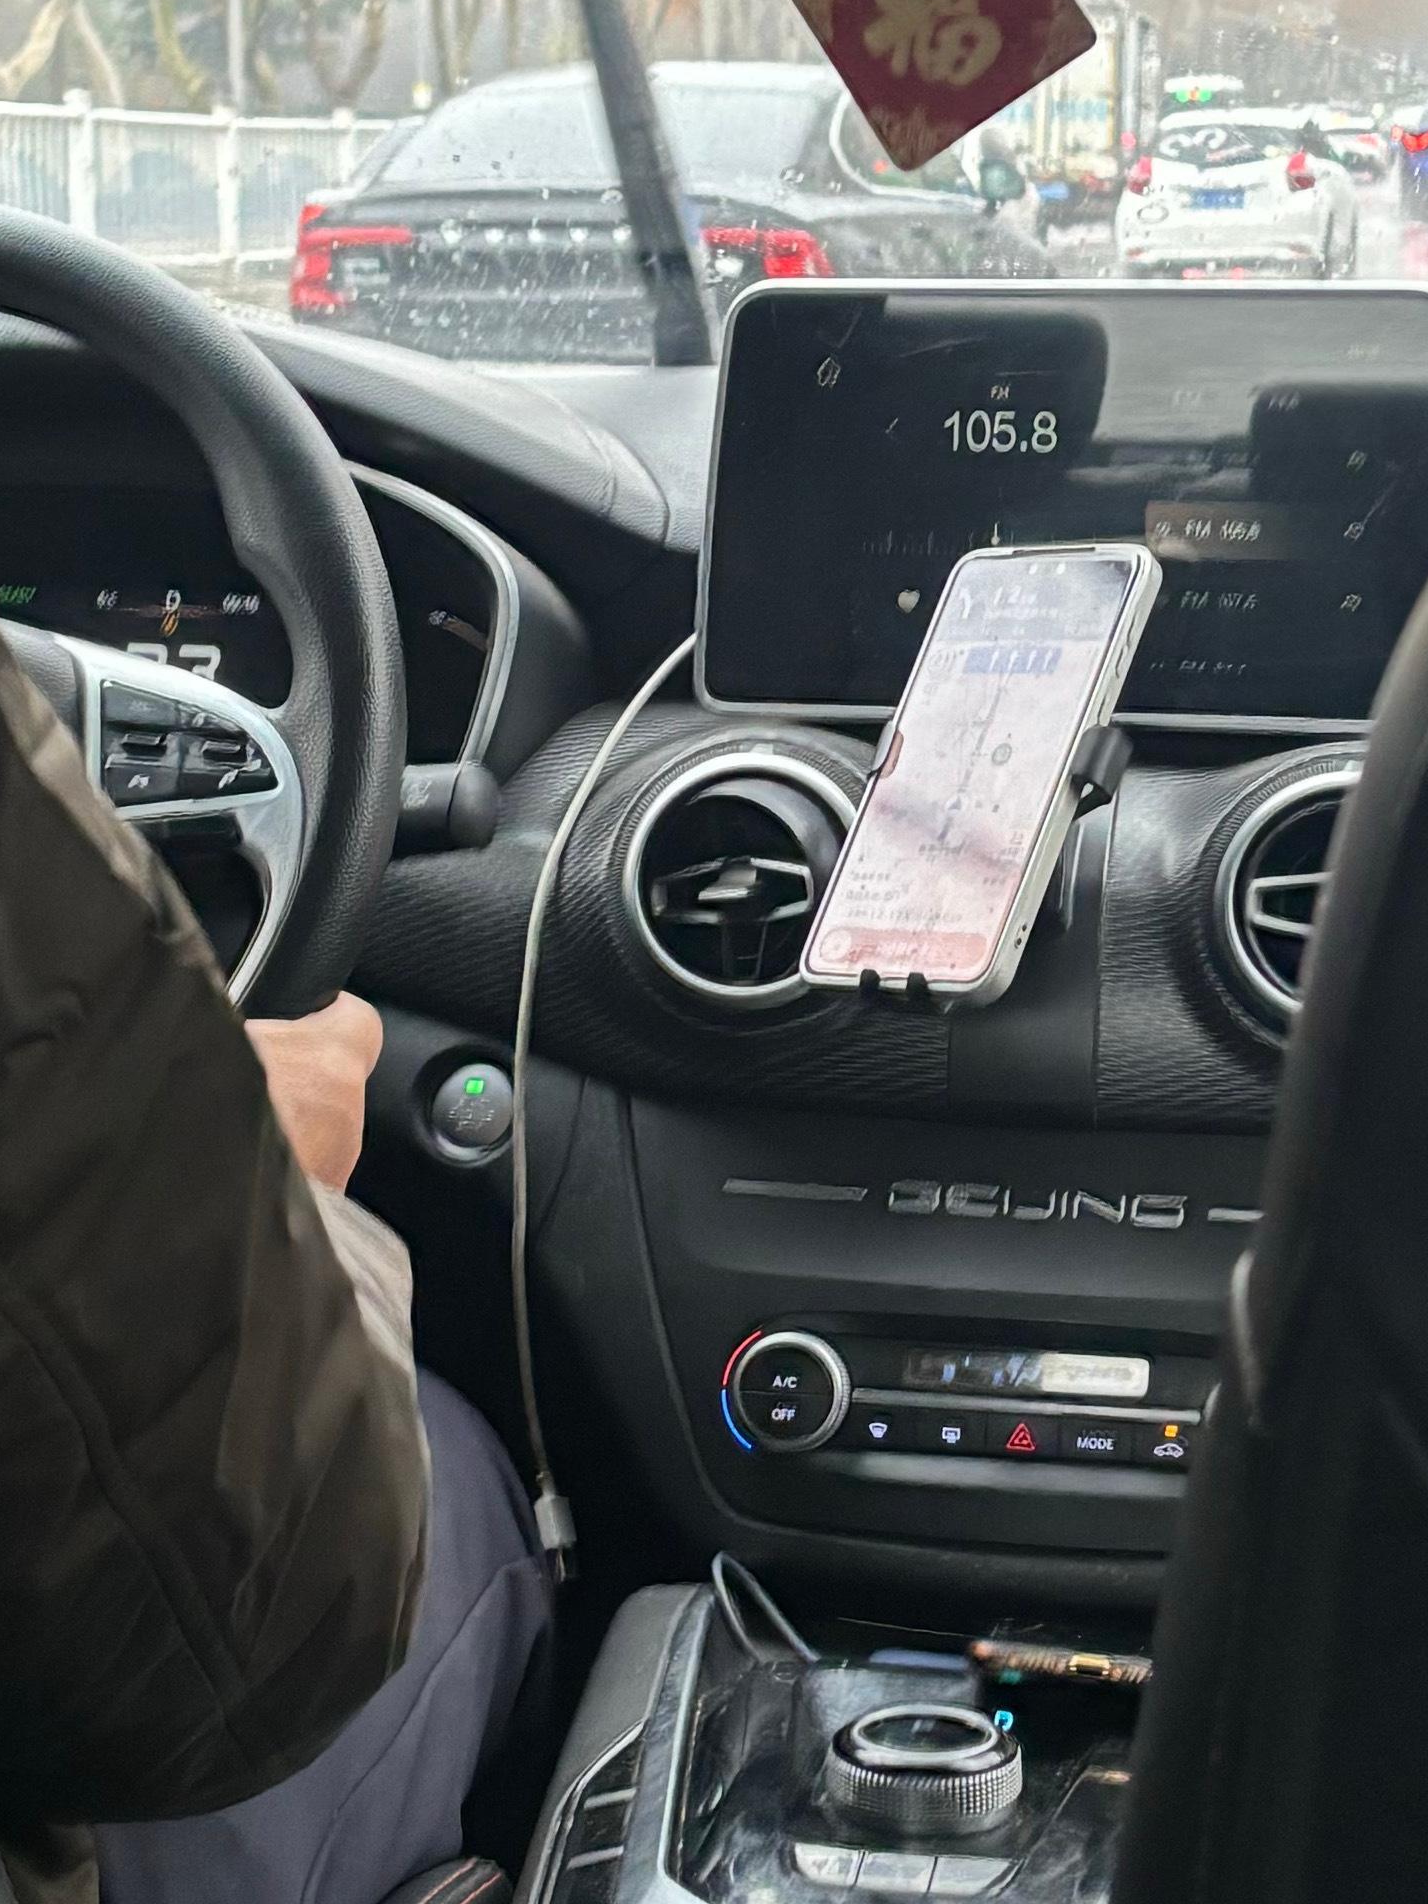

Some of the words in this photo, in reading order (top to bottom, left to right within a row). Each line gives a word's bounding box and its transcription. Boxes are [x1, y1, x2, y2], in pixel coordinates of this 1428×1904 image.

[943, 409, 1058, 454] 105.8
[888, 1179, 1188, 1229] BEIJING
[772, 1375, 798, 1389] A/C
[771, 1407, 796, 1421] OFF
[1076, 1436, 1114, 1451] MODE
